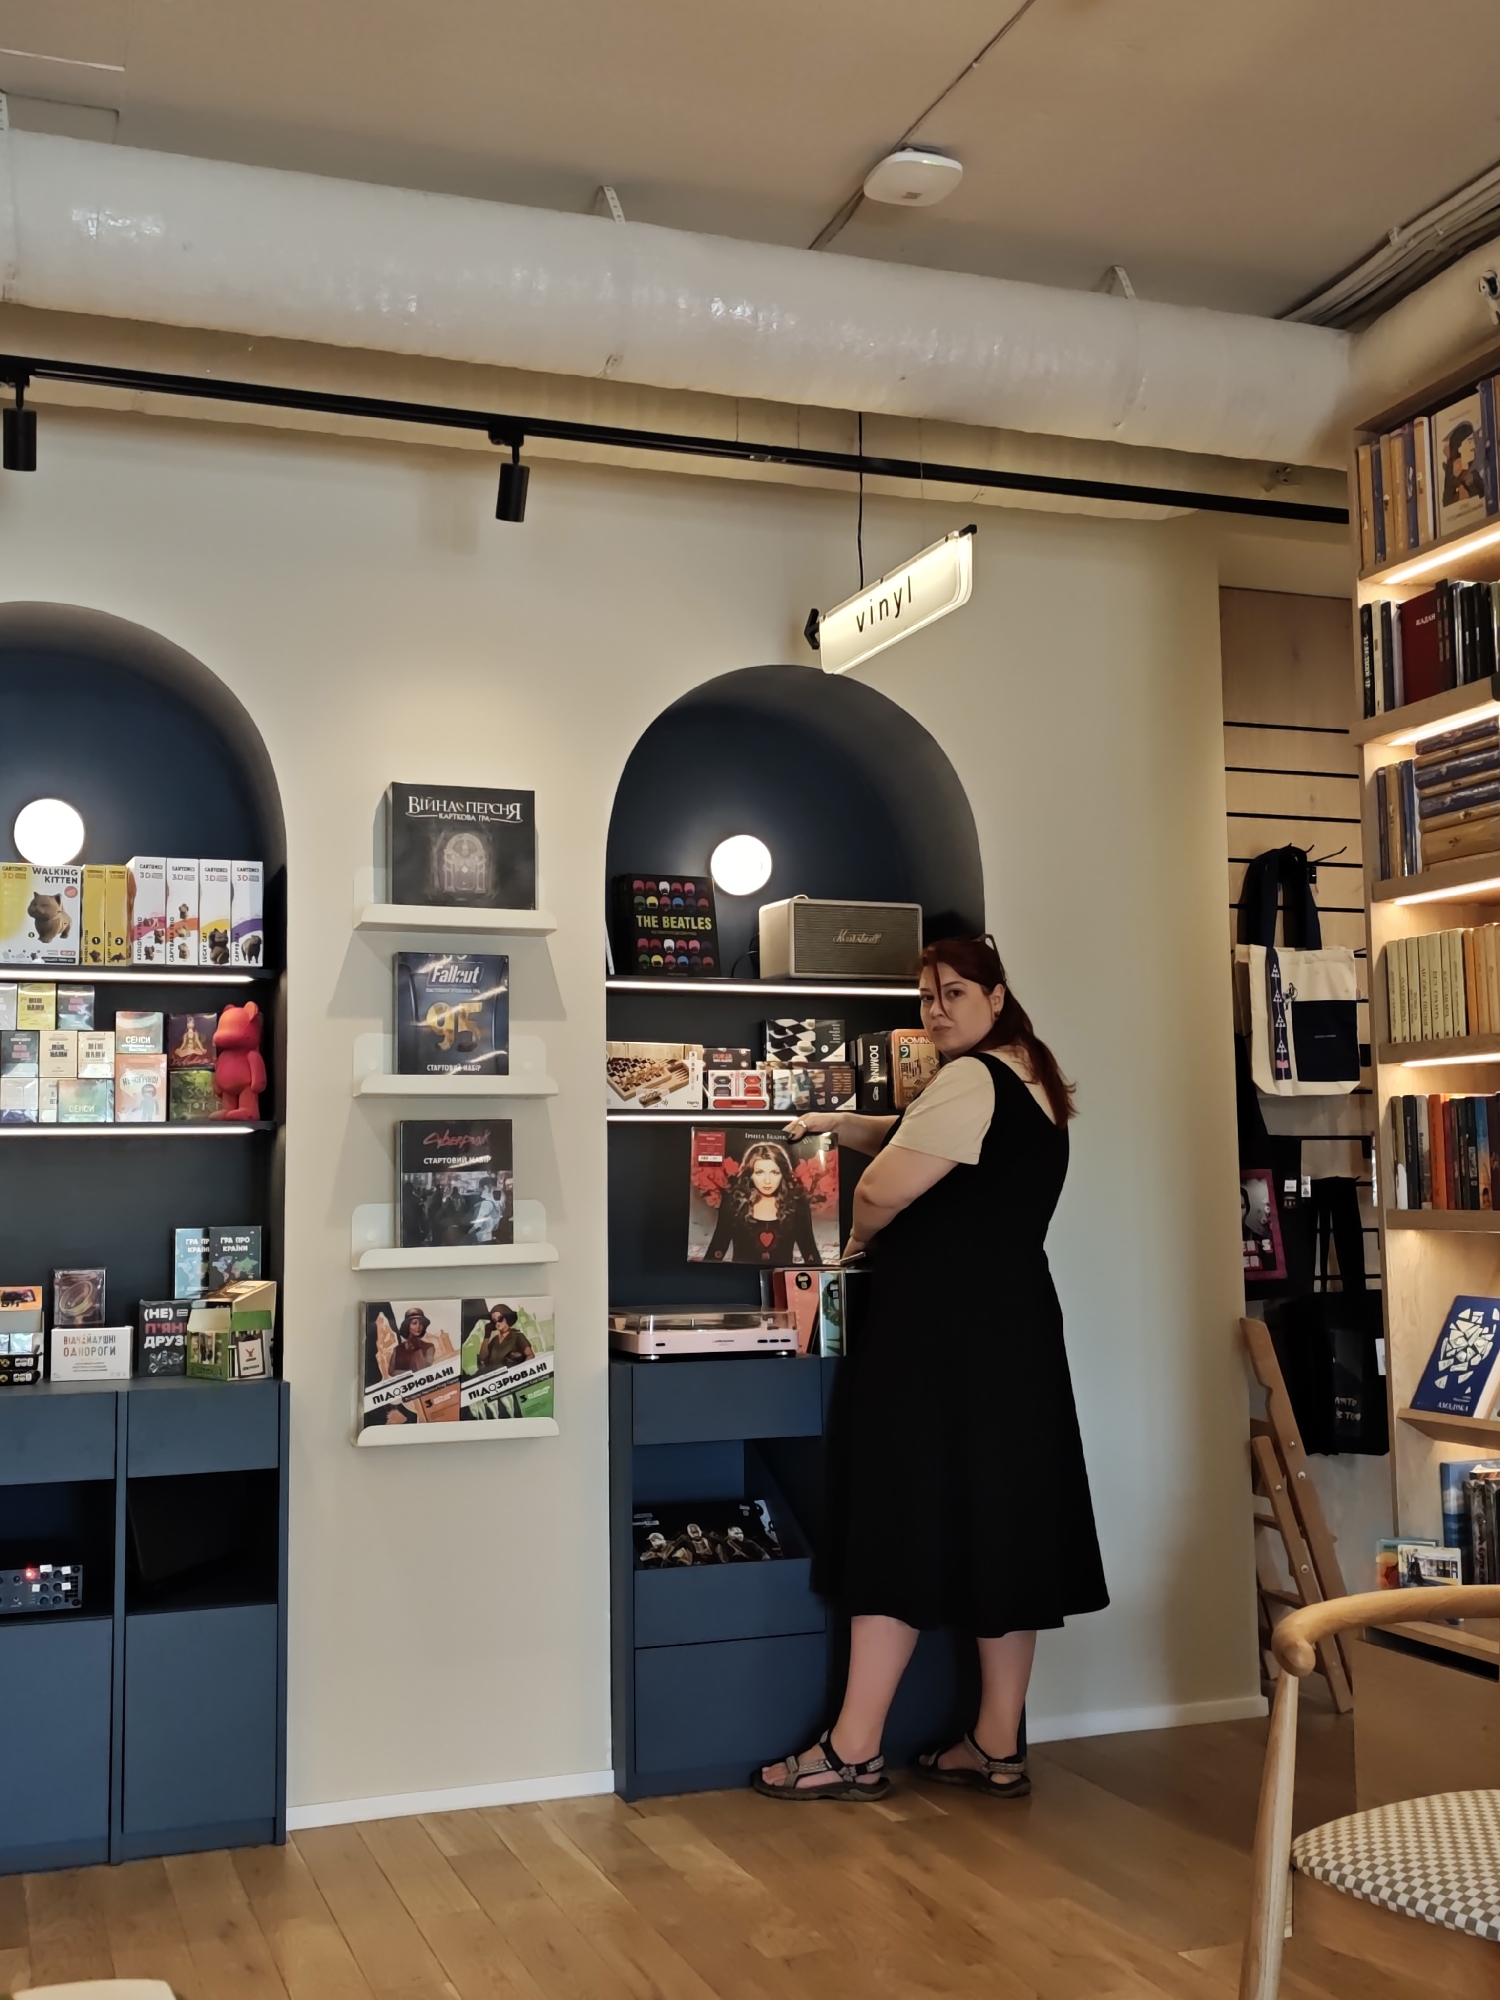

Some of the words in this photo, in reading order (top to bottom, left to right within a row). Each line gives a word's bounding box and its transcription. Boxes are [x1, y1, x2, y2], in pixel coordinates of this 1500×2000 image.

[856, 575, 912, 633] vinyl
[32, 867, 78, 876] WALKING
[45, 876, 78, 884] KITTEN
[636, 915, 659, 928] THE
[662, 916, 712, 930] BEATLES
[431, 965, 480, 983] Fallout
[125, 1036, 151, 1044] СЕНСИ
[901, 1046, 910, 1058] 9
[869, 1045, 879, 1083] DOMINO
[68, 1104, 95, 1113] СЕНСИ
[423, 1155, 467, 1165] СТАРТОВИЙ
[188, 1245, 210, 1253] КРАЇН
[222, 1244, 248, 1252] КРАЇНИ
[144, 1308, 174, 1321] (НЕ)
[63, 1334, 116, 1345] ВІДЧАЙДУШНІ
[63, 1347, 116, 1357] ОДНОРОГИ
[372, 1367, 454, 1405] ПІДОЗРЮВАНІ
[468, 1362, 547, 1400] ПІДОЗРЮВАНІ
